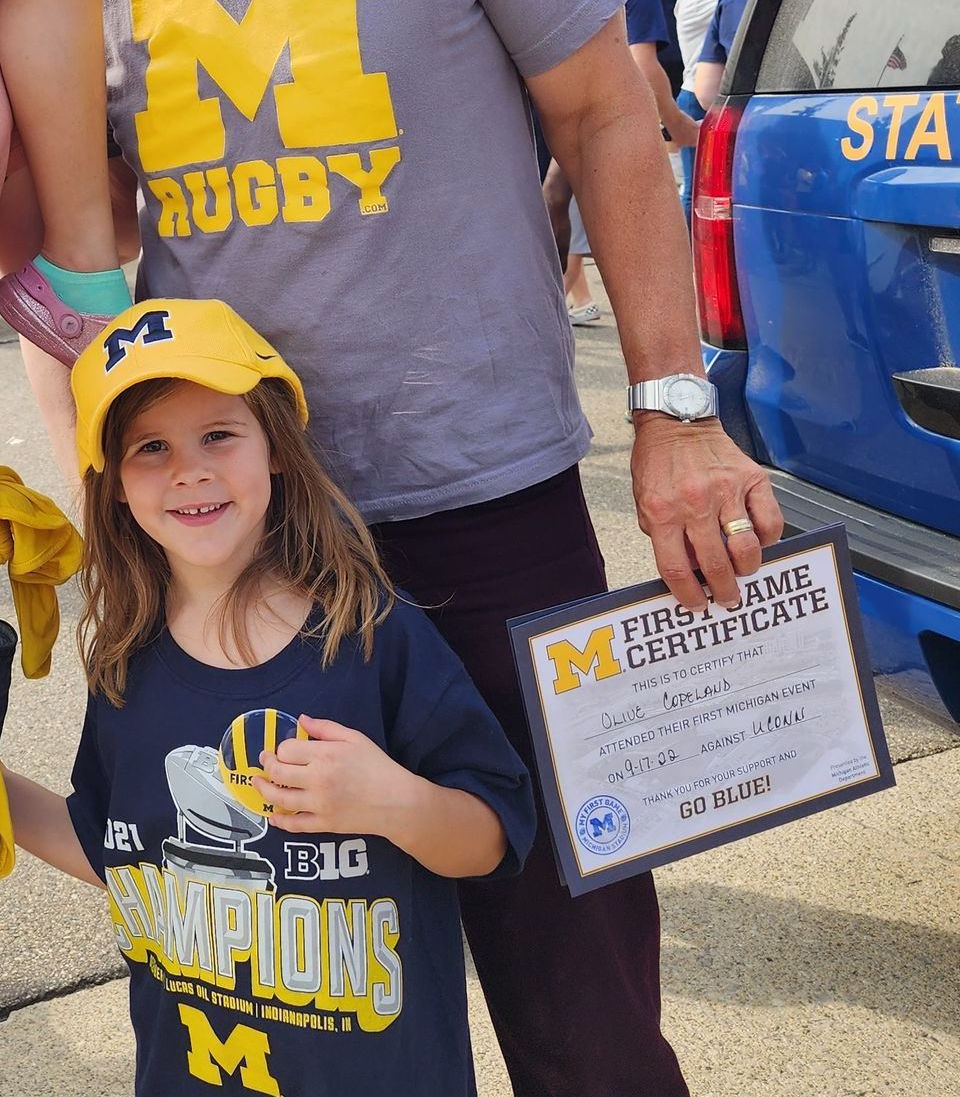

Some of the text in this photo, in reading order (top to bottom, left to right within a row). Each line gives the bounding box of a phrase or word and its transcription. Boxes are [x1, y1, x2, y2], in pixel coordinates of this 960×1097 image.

[840, 91, 960, 161] STA
[147, 146, 401, 237] RUGBY
[103, 310, 176, 374] M
[726, 564, 813, 612] AME
[626, 587, 829, 670] CERTIFICATE
[546, 624, 622, 695] M
[632, 645, 764, 693] THIS IS TO CERTIFY THAT
[599, 679, 816, 757] ATTENDED THEIR FIRST MICHIGAN EVENT
[700, 731, 746, 754] AGAINST
[229, 773, 254, 787] FIRS
[608, 770, 624, 783] ON
[642, 749, 797, 806] THANK YOU FOR YOUR SUPPORT AND
[680, 775, 772, 820] GO BLUE!
[263, 803, 274, 813] M
[584, 798, 603, 814] FIRST
[590, 812, 617, 838] M
[165, 977, 352, 1033] LUCAS OIL STADIUM INDIANAPOLIS, IN
[178, 1003, 280, 1097] M
